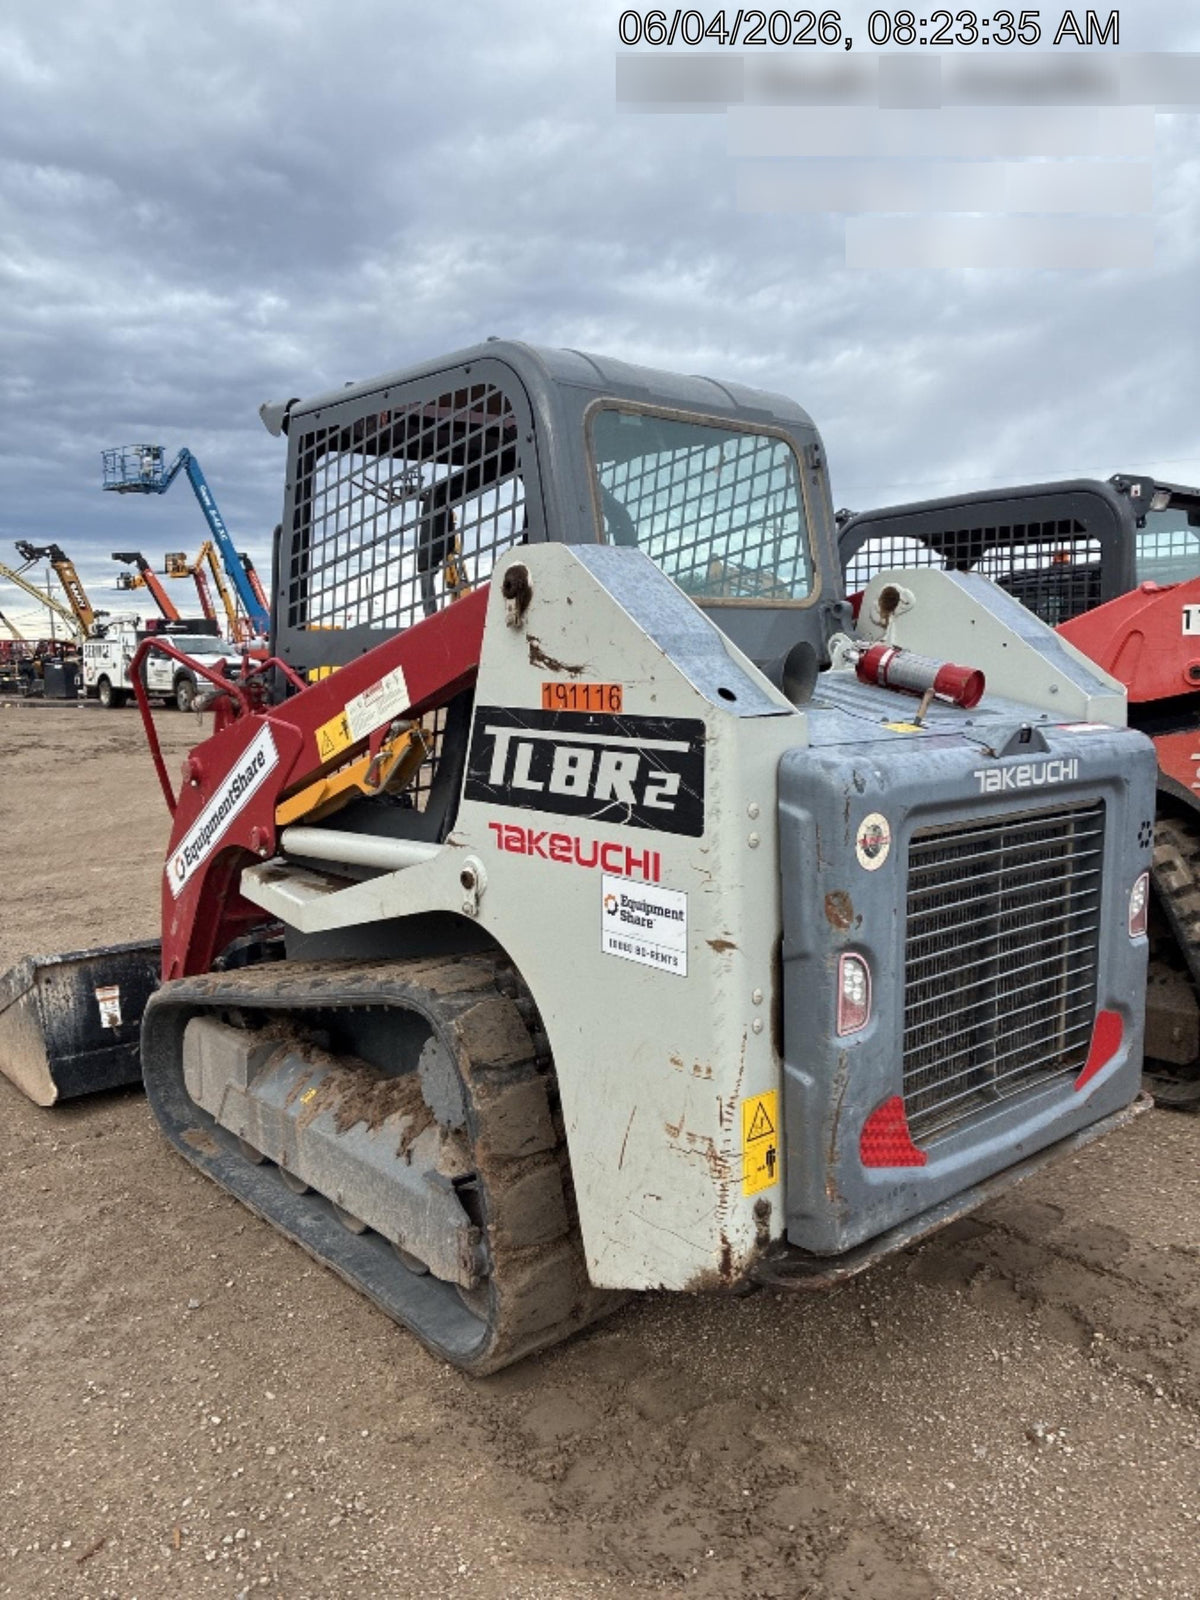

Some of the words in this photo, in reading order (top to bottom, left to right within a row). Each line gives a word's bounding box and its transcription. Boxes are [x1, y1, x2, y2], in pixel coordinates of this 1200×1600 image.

[543, 683, 622, 712] 191116
[974, 757, 1079, 794] TAKEUCHI
[183, 748, 265, 867] EquipmentShare
[488, 821, 661, 883] TAKEUCHI
[620, 894, 685, 922] Equipment
[620, 909, 654, 929] Share
